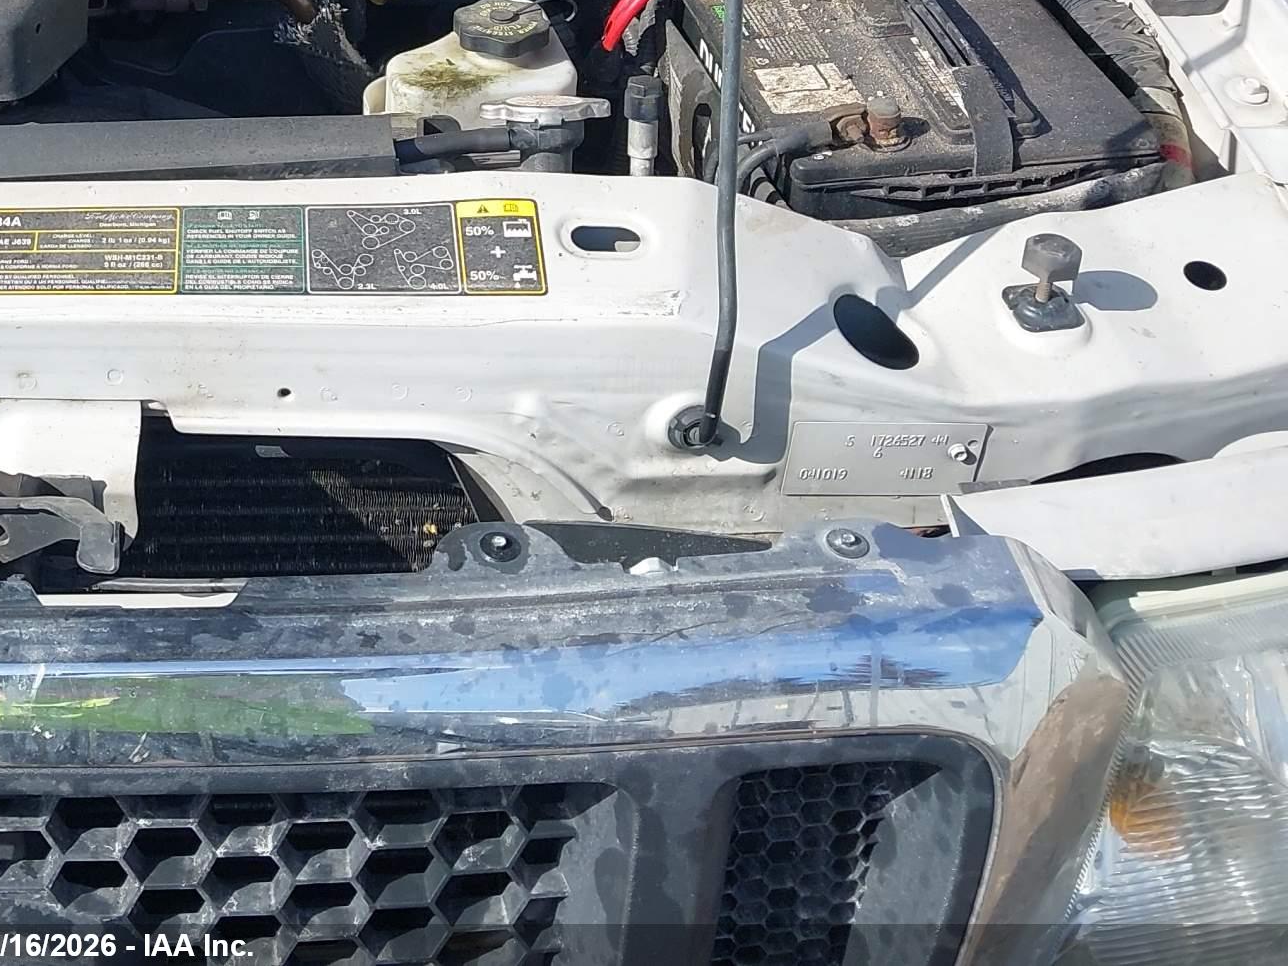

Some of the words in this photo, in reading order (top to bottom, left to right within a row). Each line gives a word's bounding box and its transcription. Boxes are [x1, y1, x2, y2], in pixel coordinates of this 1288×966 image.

[465, 226, 494, 236] 50%
[470, 270, 500, 281] 50%
[870, 434, 926, 448] 1726527
[932, 434, 950, 446] 44
[872, 448, 884, 458] 6
[800, 467, 848, 480] 041019
[899, 467, 934, 480] 4118
